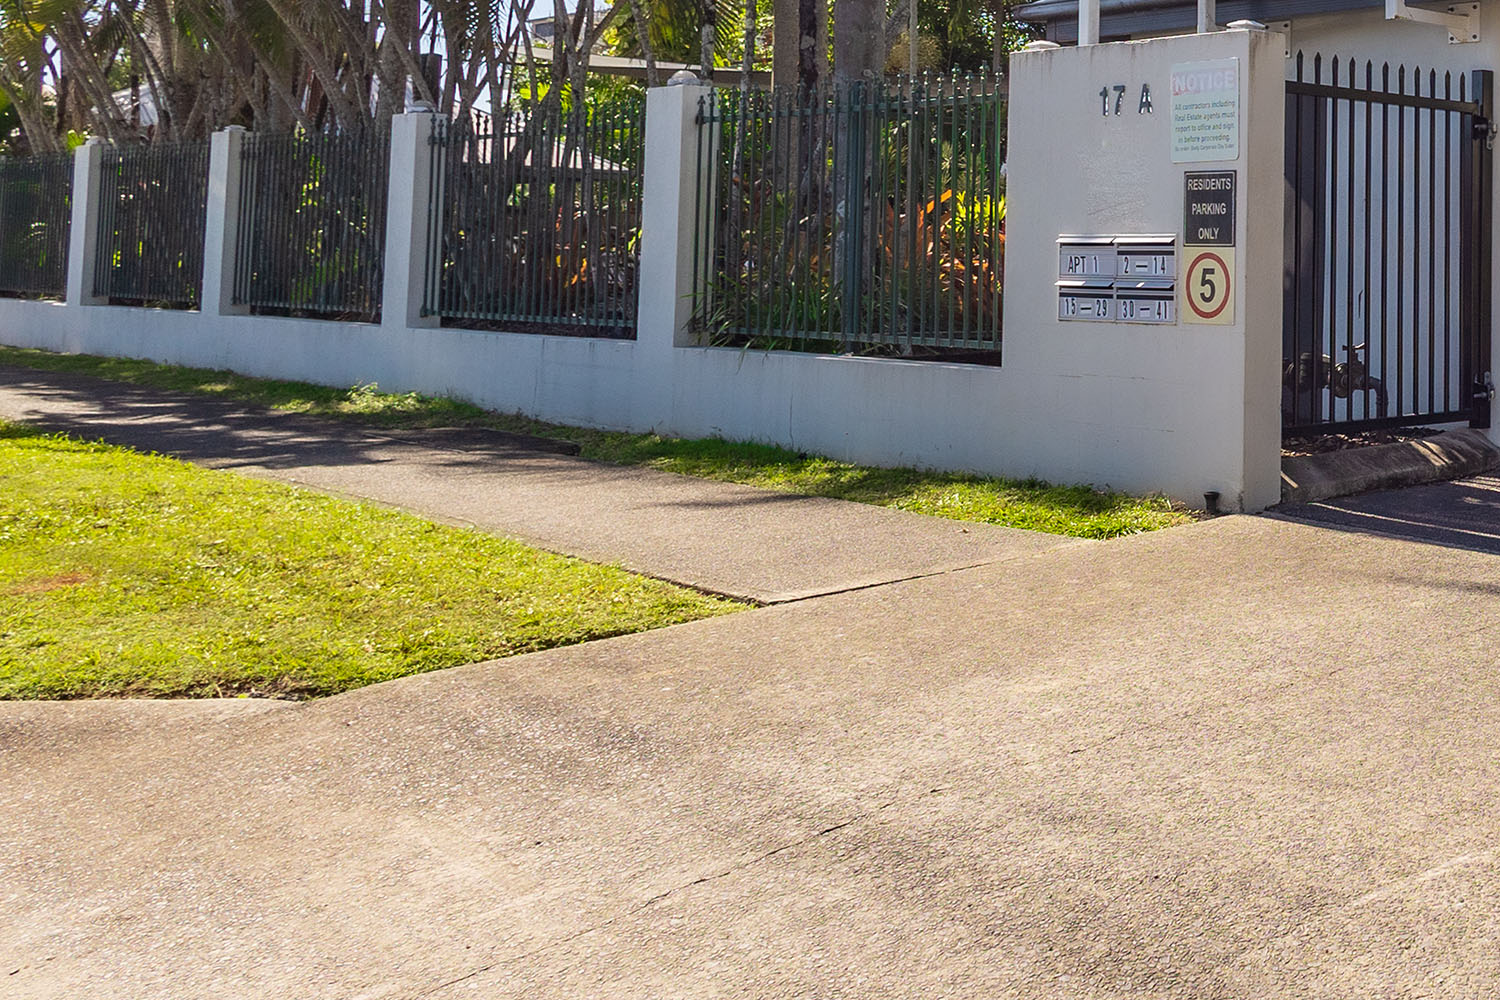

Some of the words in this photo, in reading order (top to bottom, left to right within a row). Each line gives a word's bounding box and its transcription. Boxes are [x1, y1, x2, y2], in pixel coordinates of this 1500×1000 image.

[1174, 70, 1235, 92] NOTICE
[1099, 85, 1126, 116] 17
[1138, 83, 1153, 115] A
[1187, 178, 1231, 190] RESIDENTS
[1191, 203, 1227, 215] PARKING
[1198, 227, 1219, 240] ONLY
[1067, 255, 1086, 273] APT
[1093, 255, 1098, 273] 1
[1199, 268, 1216, 303] 5
